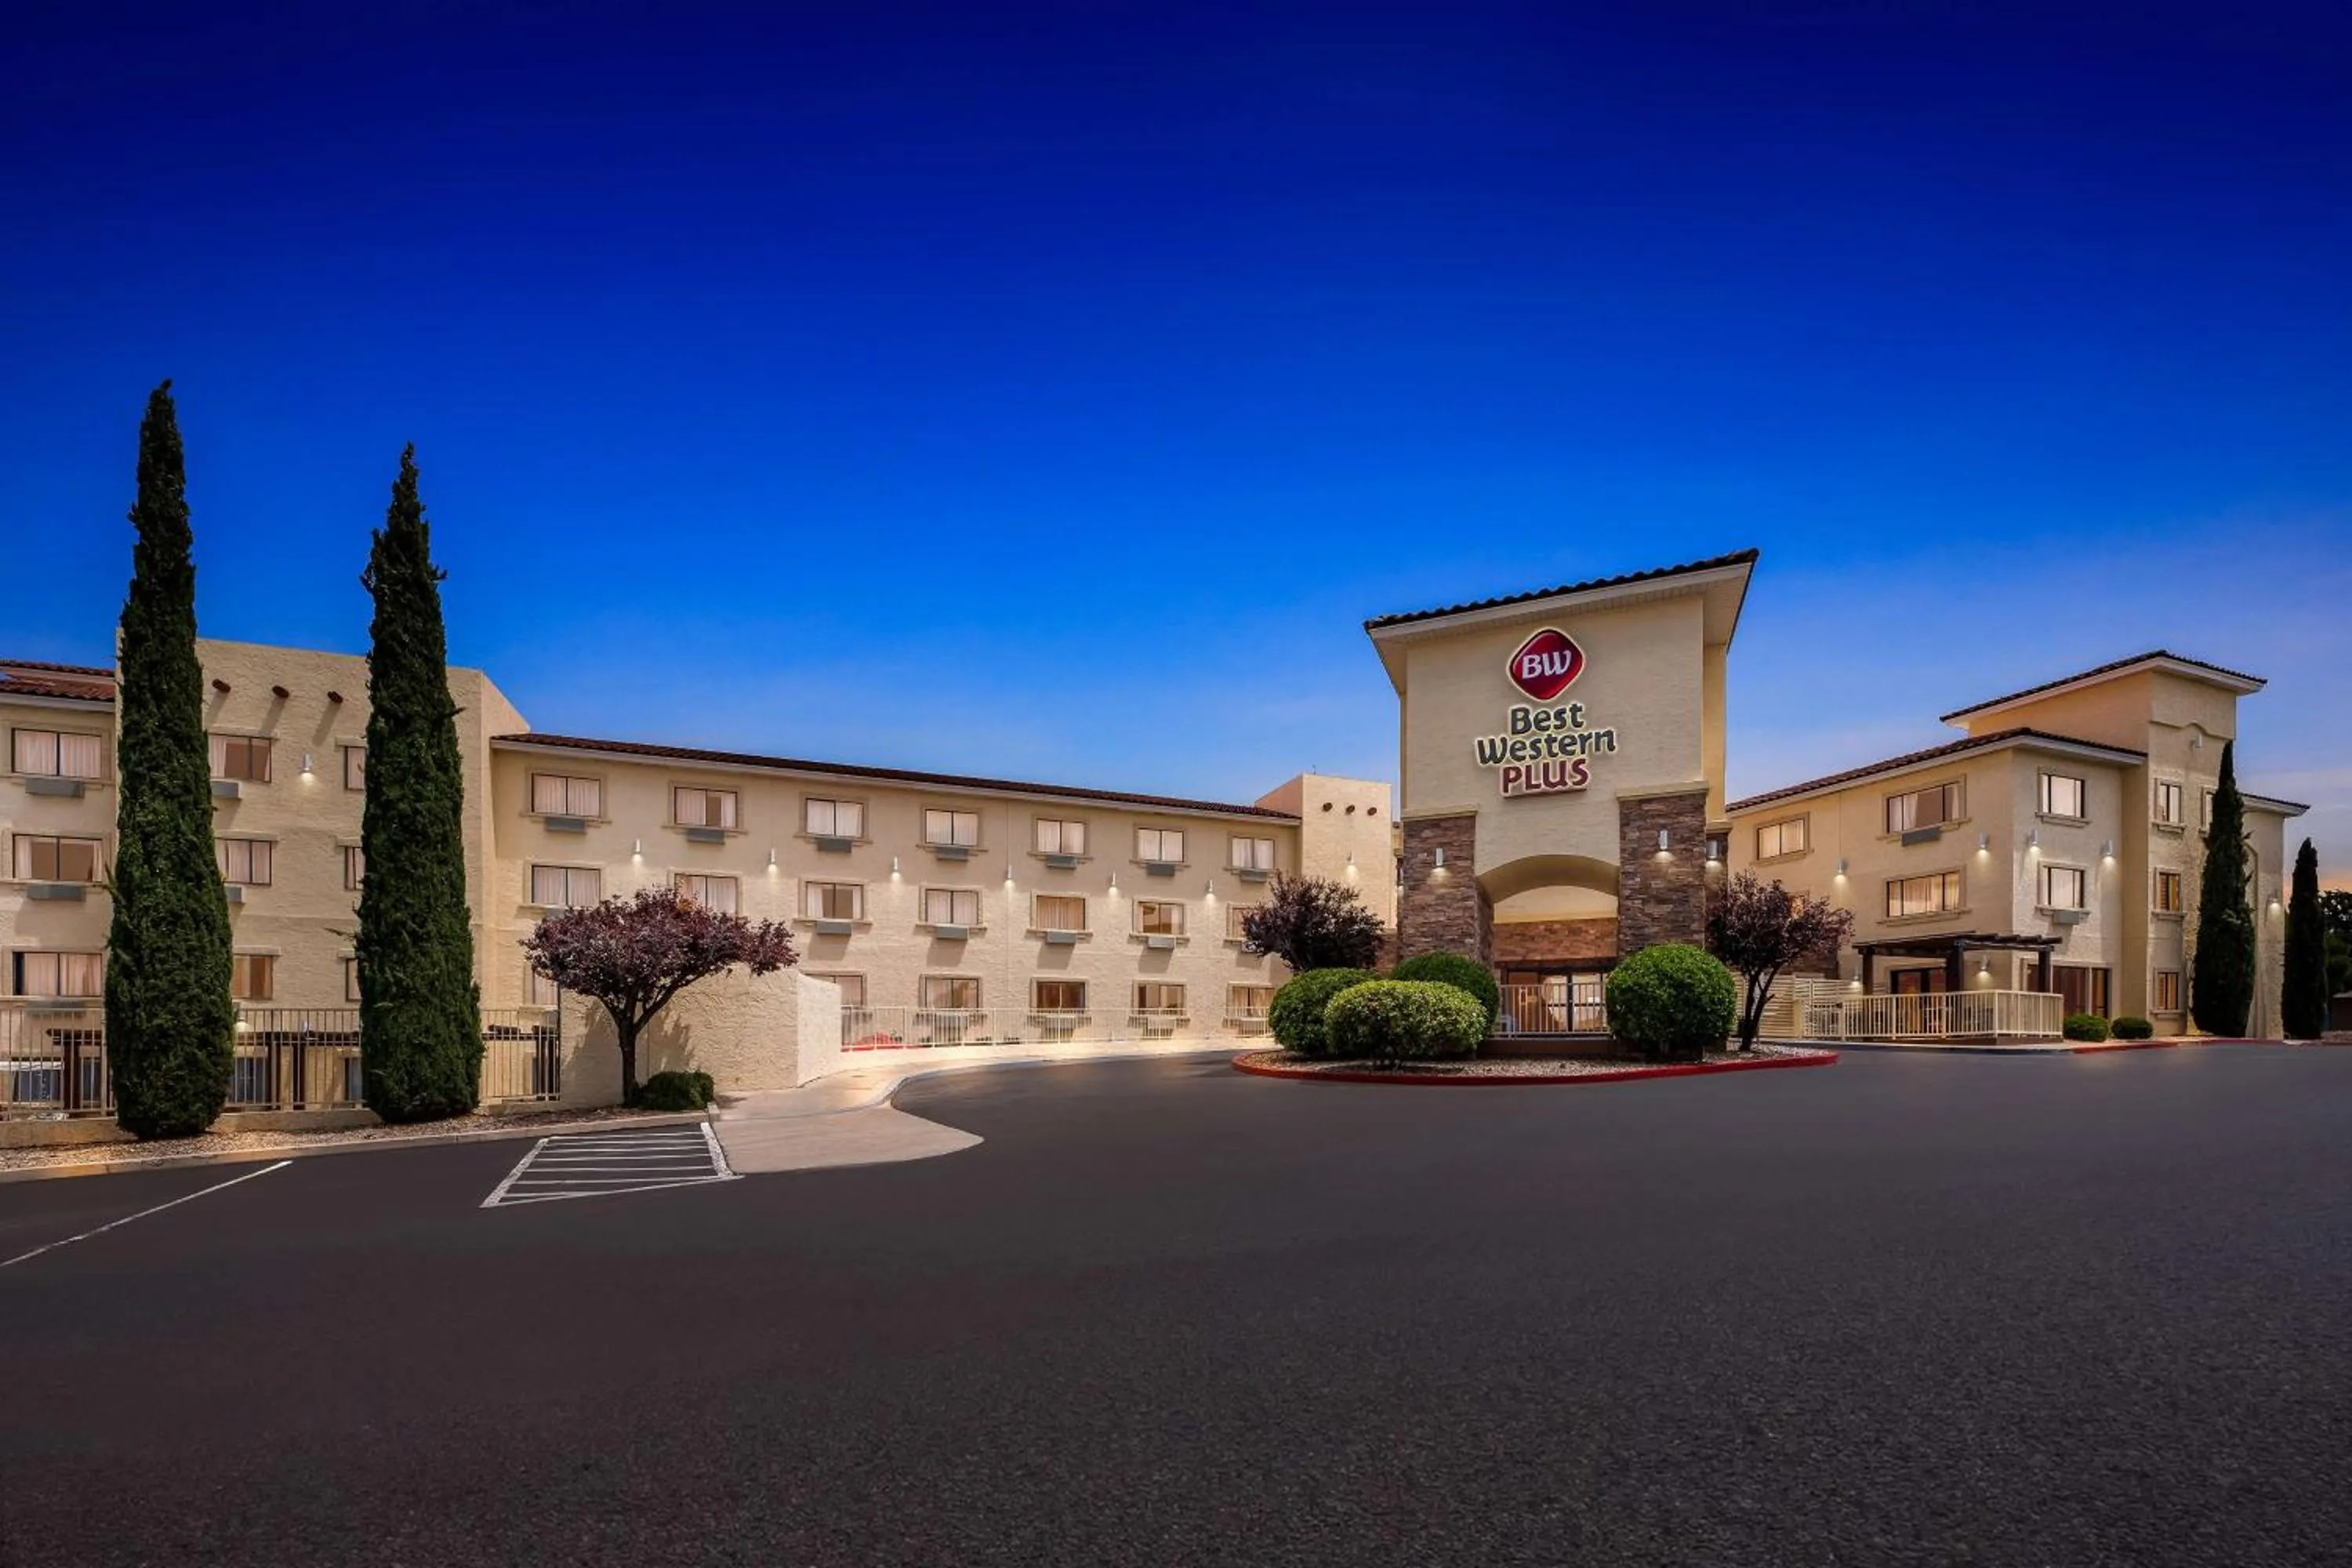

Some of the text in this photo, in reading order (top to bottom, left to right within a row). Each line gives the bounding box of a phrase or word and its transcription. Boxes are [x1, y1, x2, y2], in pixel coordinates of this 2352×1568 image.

[1522, 650, 1572, 679] BW
[1510, 703, 1584, 735] Best
[1476, 729, 1616, 764] Western
[1502, 758, 1589, 793] PLUS
